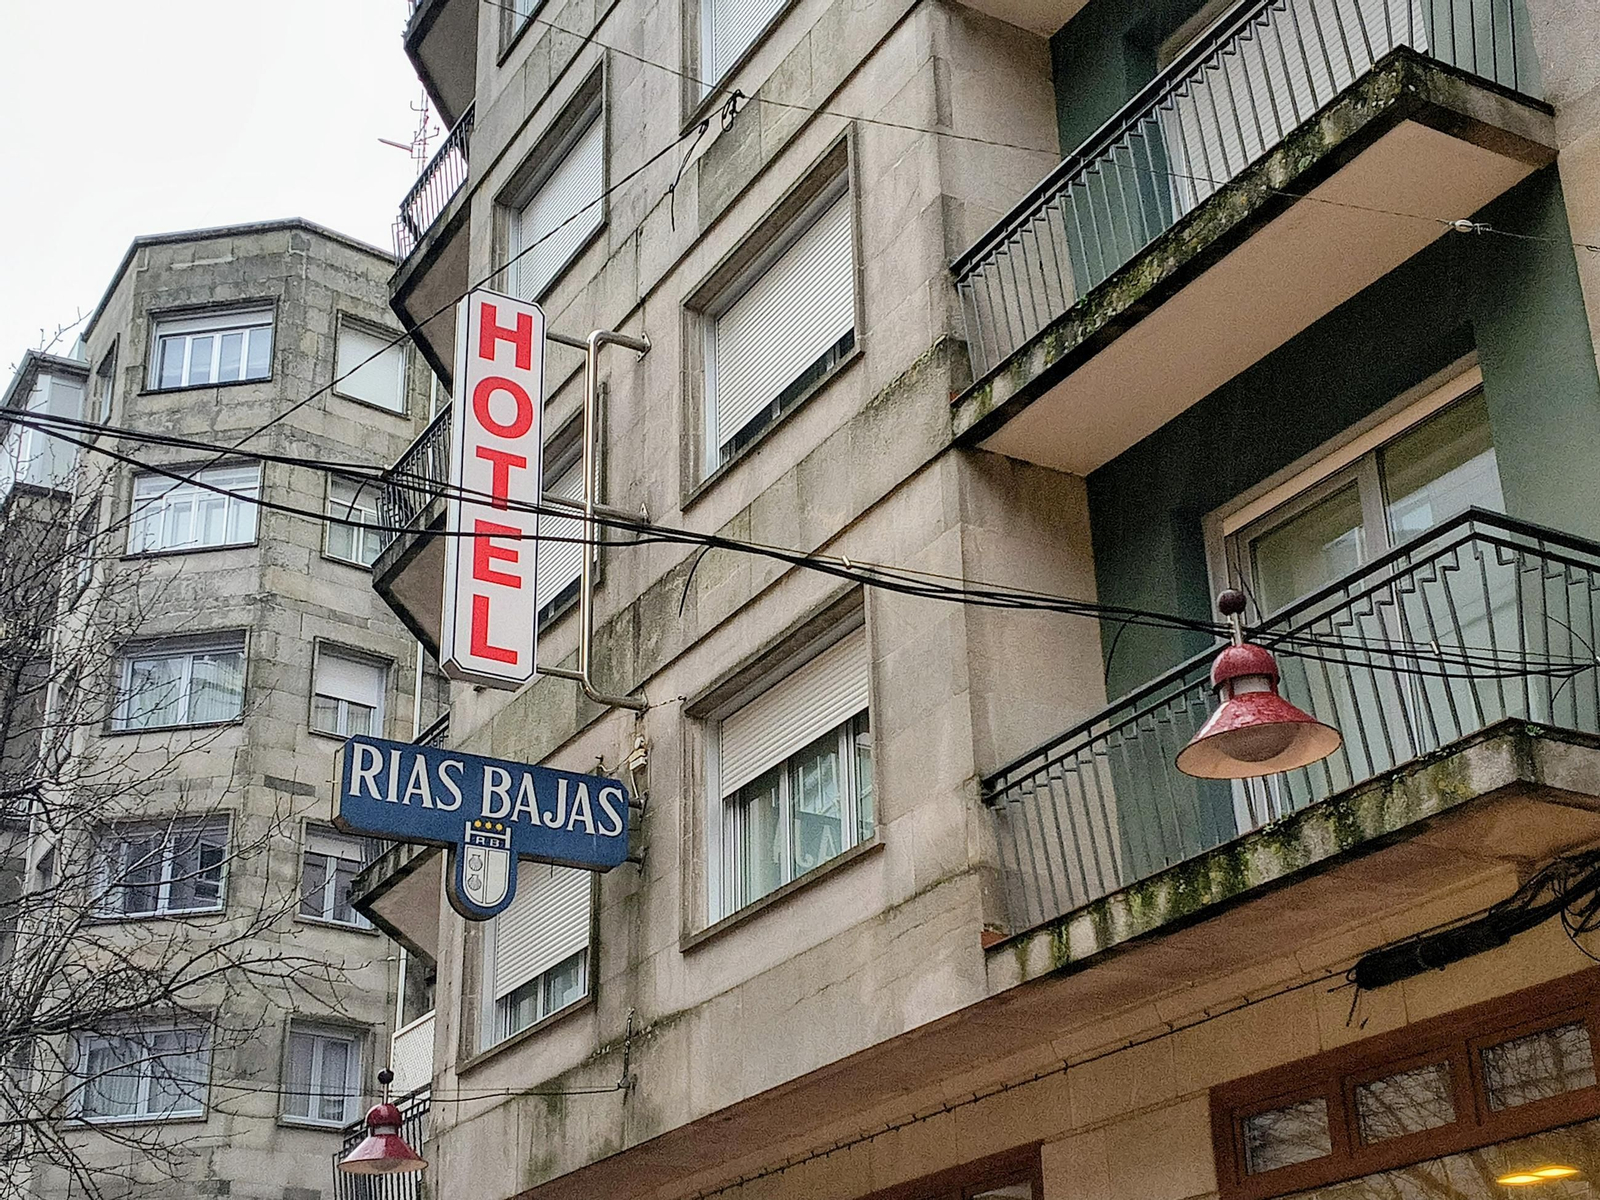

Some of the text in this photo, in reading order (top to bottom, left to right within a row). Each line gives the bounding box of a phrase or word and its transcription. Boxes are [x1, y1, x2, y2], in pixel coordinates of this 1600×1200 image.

[469, 301, 533, 665] HOTEL
[348, 742, 624, 837] RIAS BAJAS
